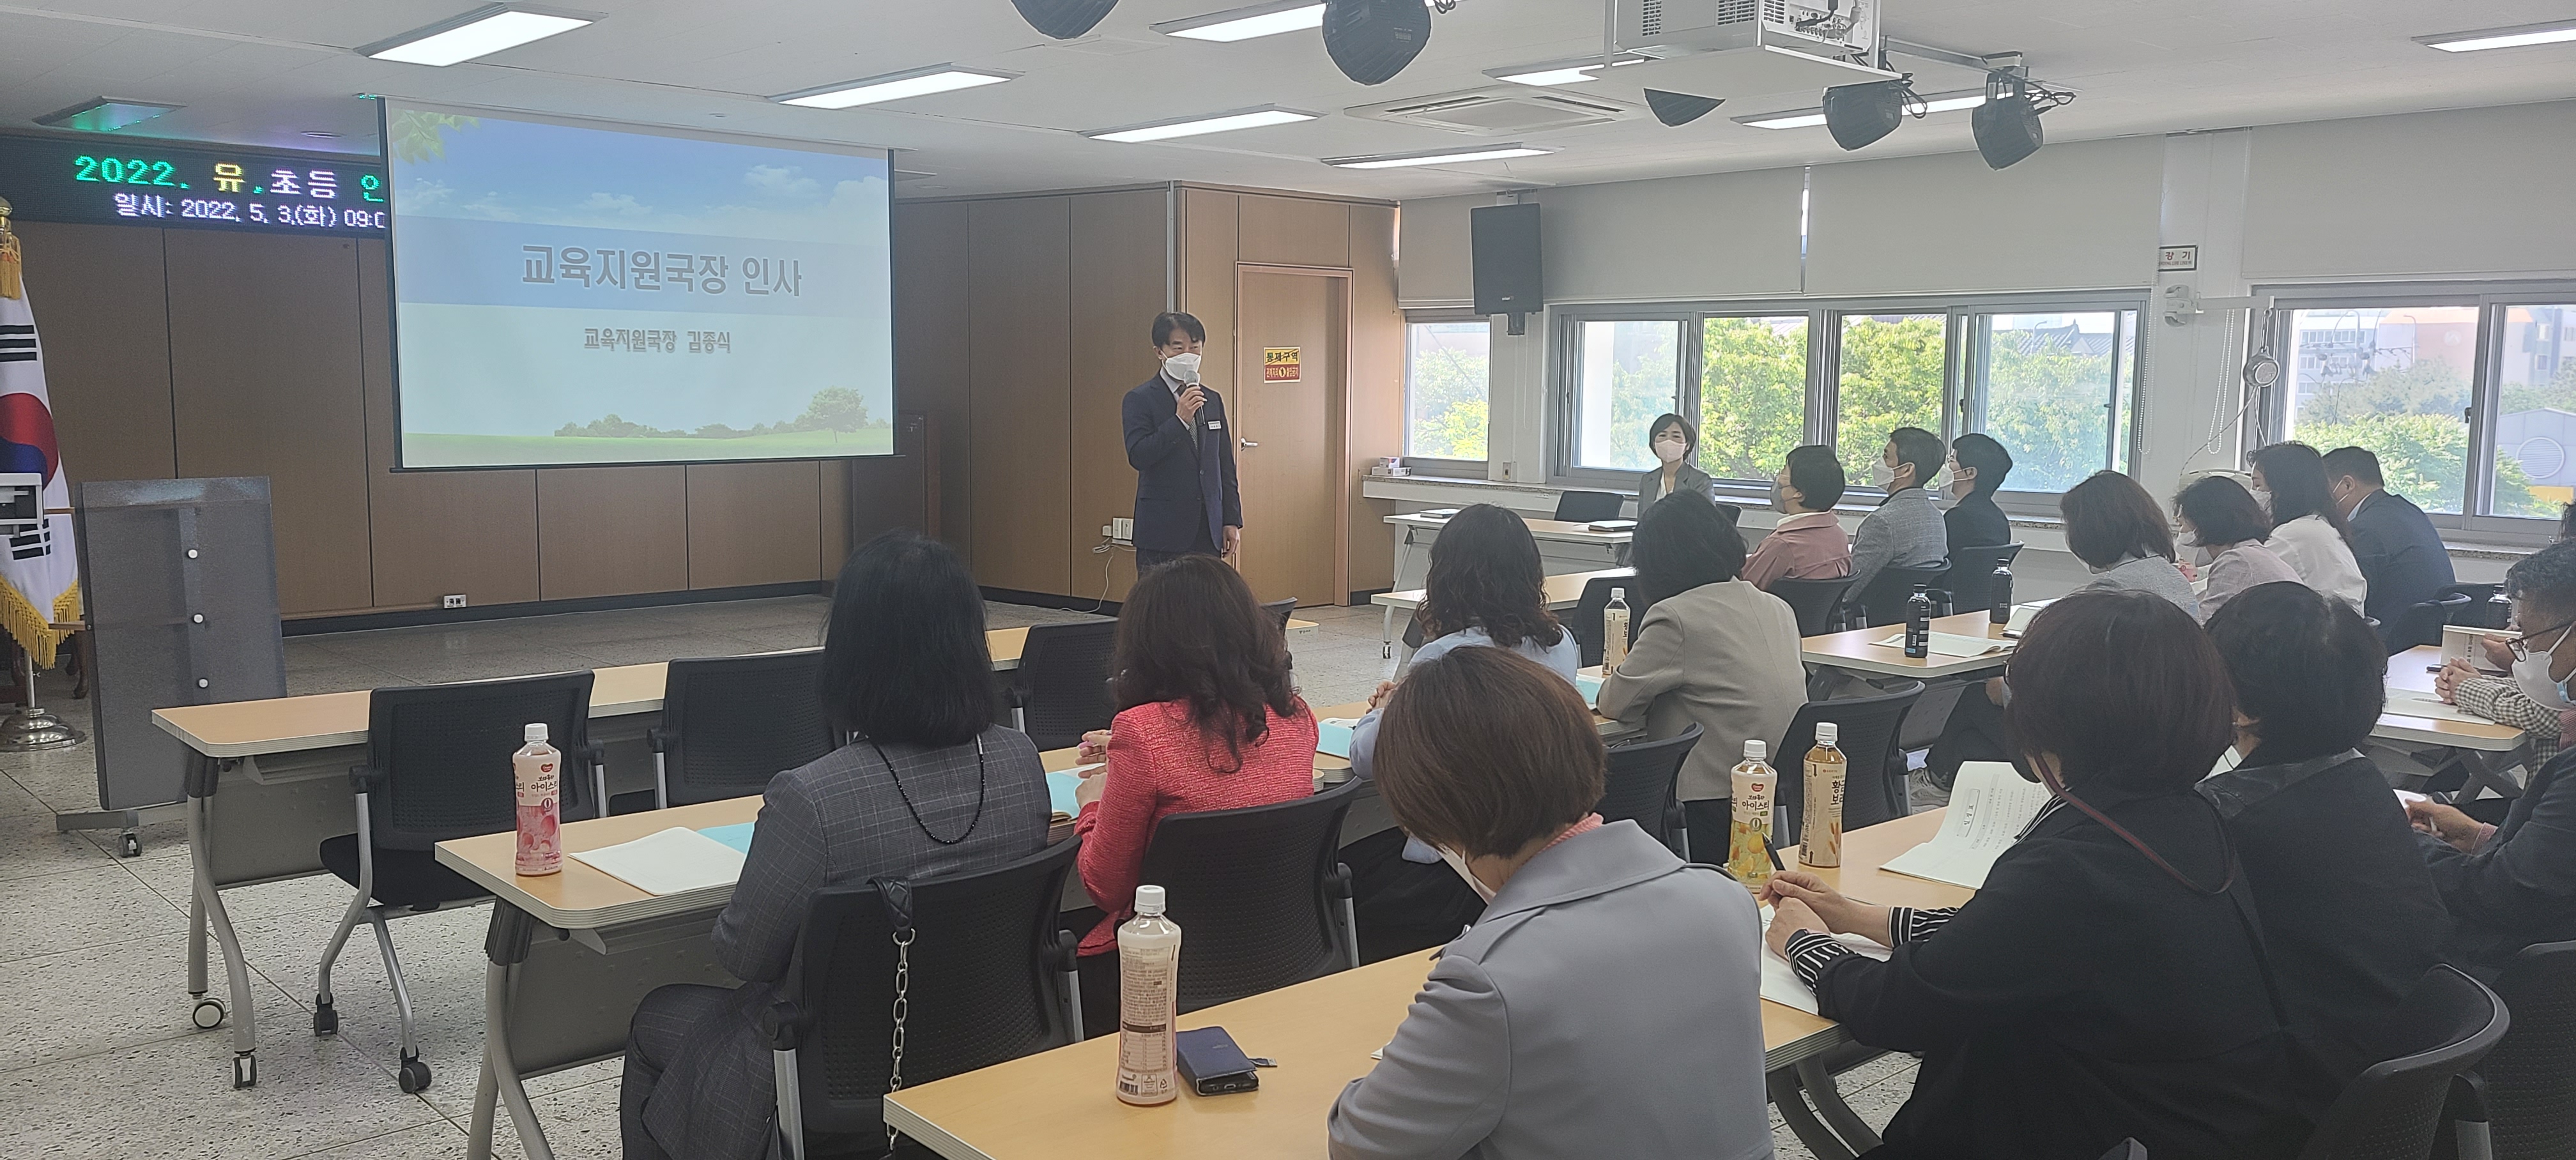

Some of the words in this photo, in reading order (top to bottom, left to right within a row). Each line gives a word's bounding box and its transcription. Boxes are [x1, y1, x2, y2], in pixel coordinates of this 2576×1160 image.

[75, 155, 190, 190] 2022.
[213, 162, 337, 199] 유,초등
[113, 192, 173, 218] 일시:
[2165, 251, 2191, 261] 강기
[522, 245, 729, 294] 교육지원국장
[742, 257, 802, 296] 인사
[584, 328, 677, 352] 교육지원국장
[687, 330, 731, 353] 김종식
[1266, 352, 1298, 362] 통제구역
[1742, 800, 1770, 811] 아이스티
